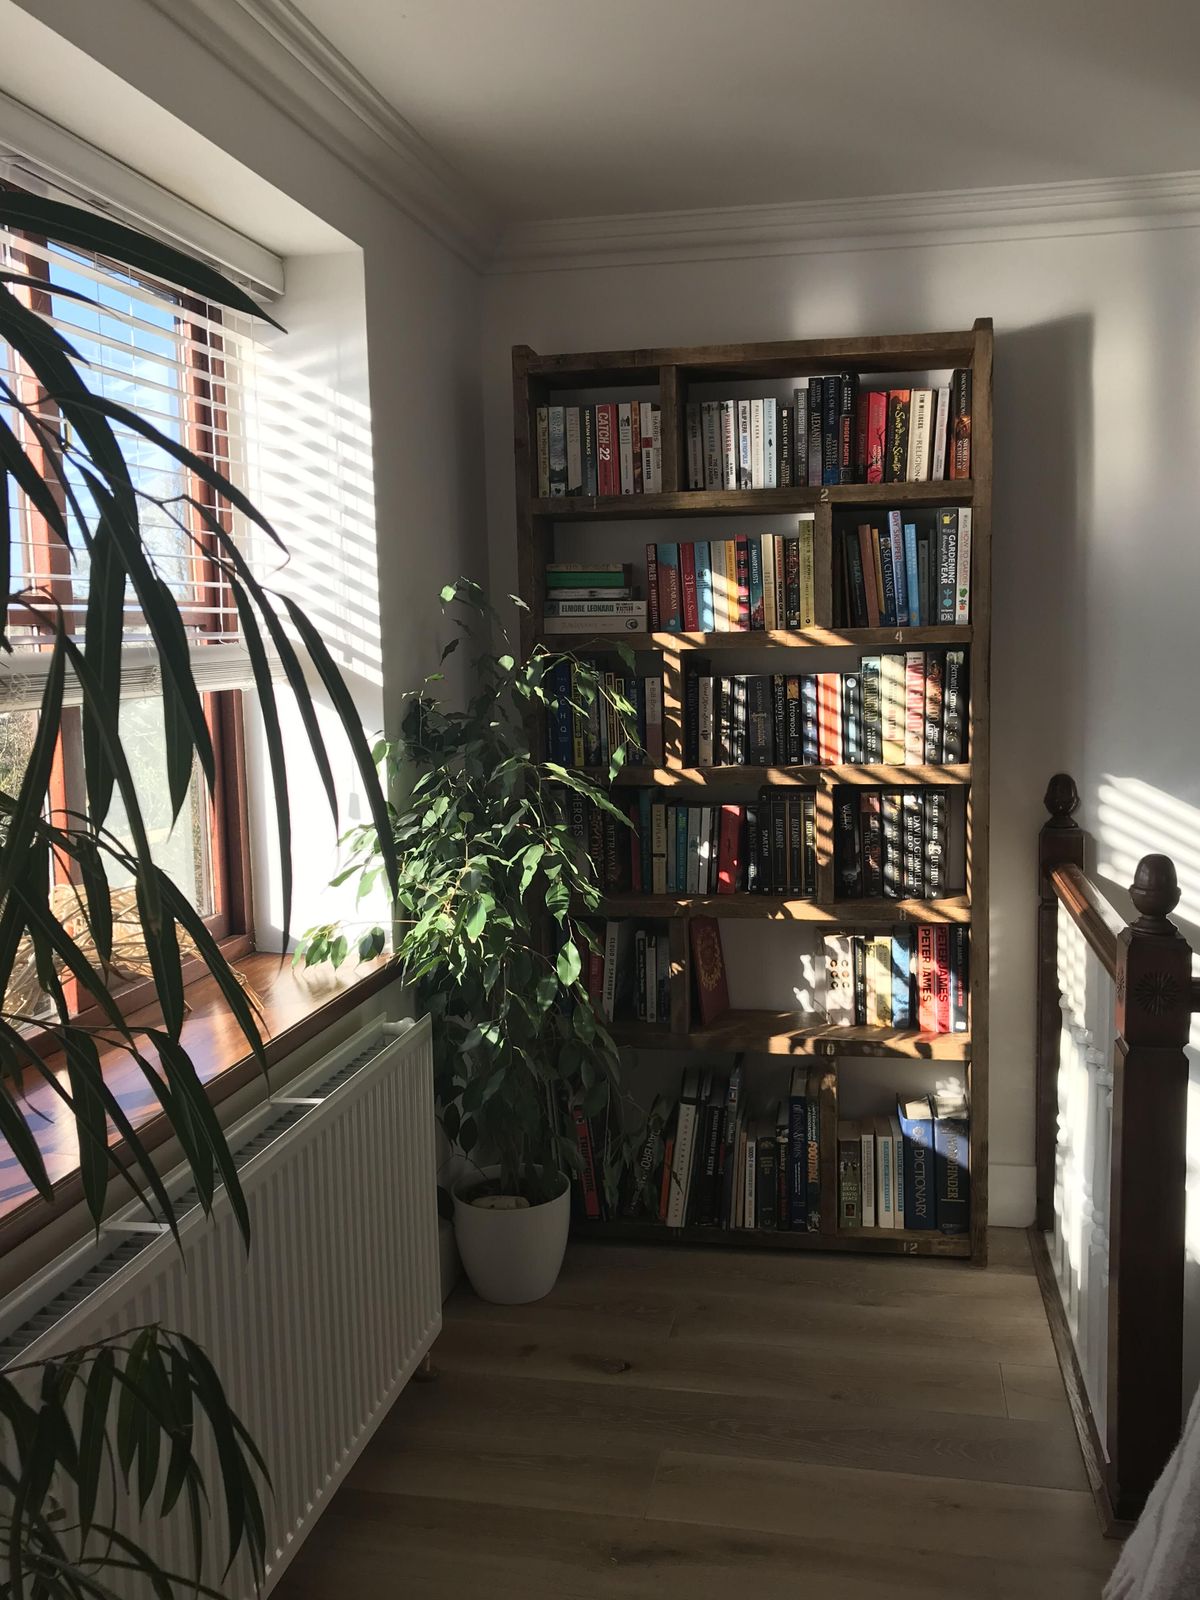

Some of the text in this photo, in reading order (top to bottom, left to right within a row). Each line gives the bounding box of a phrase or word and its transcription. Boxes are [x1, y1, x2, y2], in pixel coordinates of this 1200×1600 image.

[797, 392, 806, 435] STEVEN PRESSFIELD
[828, 399, 835, 409] OF
[598, 412, 611, 462] CATCH-22
[725, 435, 733, 453] KERR
[782, 437, 788, 445] OF
[914, 440, 924, 477] RELIGION
[819, 488, 830, 502] 2
[892, 512, 902, 560] DAY SKIPPER
[962, 549, 969, 559] TO
[751, 549, 759, 584] IMMORTALISTS
[883, 549, 893, 598] SEA CHANGE
[940, 562, 949, 585] YEAR
[946, 534, 956, 584] GARDENING
[669, 569, 677, 610] SHANTARAM
[684, 574, 695, 621] 31 Bond Street
[561, 604, 585, 613] ELMORE
[587, 604, 615, 613] LEONARD
[940, 613, 955, 623] DK
[894, 630, 904, 643] 4
[649, 687, 657, 698] Bill
[777, 686, 785, 720] MELMOTH
[863, 677, 880, 723] STALINGRAD
[907, 663, 925, 732] WATERLOO
[949, 664, 960, 717] Bernard Cornwell
[789, 700, 800, 737] Arrowood
[572, 793, 584, 838] HEROES
[775, 818, 784, 848] ALEXANDER
[791, 818, 800, 848] ALEXANDER
[805, 821, 813, 846] ALEXANDER
[607, 825, 616, 870] BETRAYAL
[907, 842, 913, 851] OF
[913, 815, 922, 888] DAVID GEMMELL
[930, 855, 939, 886] LUSTRUM
[608, 937, 616, 957] CLOUD
[921, 929, 932, 1003] PETER JAMES
[938, 928, 948, 1003] PETER JAMES
[606, 968, 614, 1000] SPARROWS
[807, 1140, 819, 1184] FOOTBALL
[946, 1134, 959, 1200] WORDFINDER
[913, 1149, 928, 1218] DICTIONARY
[903, 1241, 918, 1255] 12
